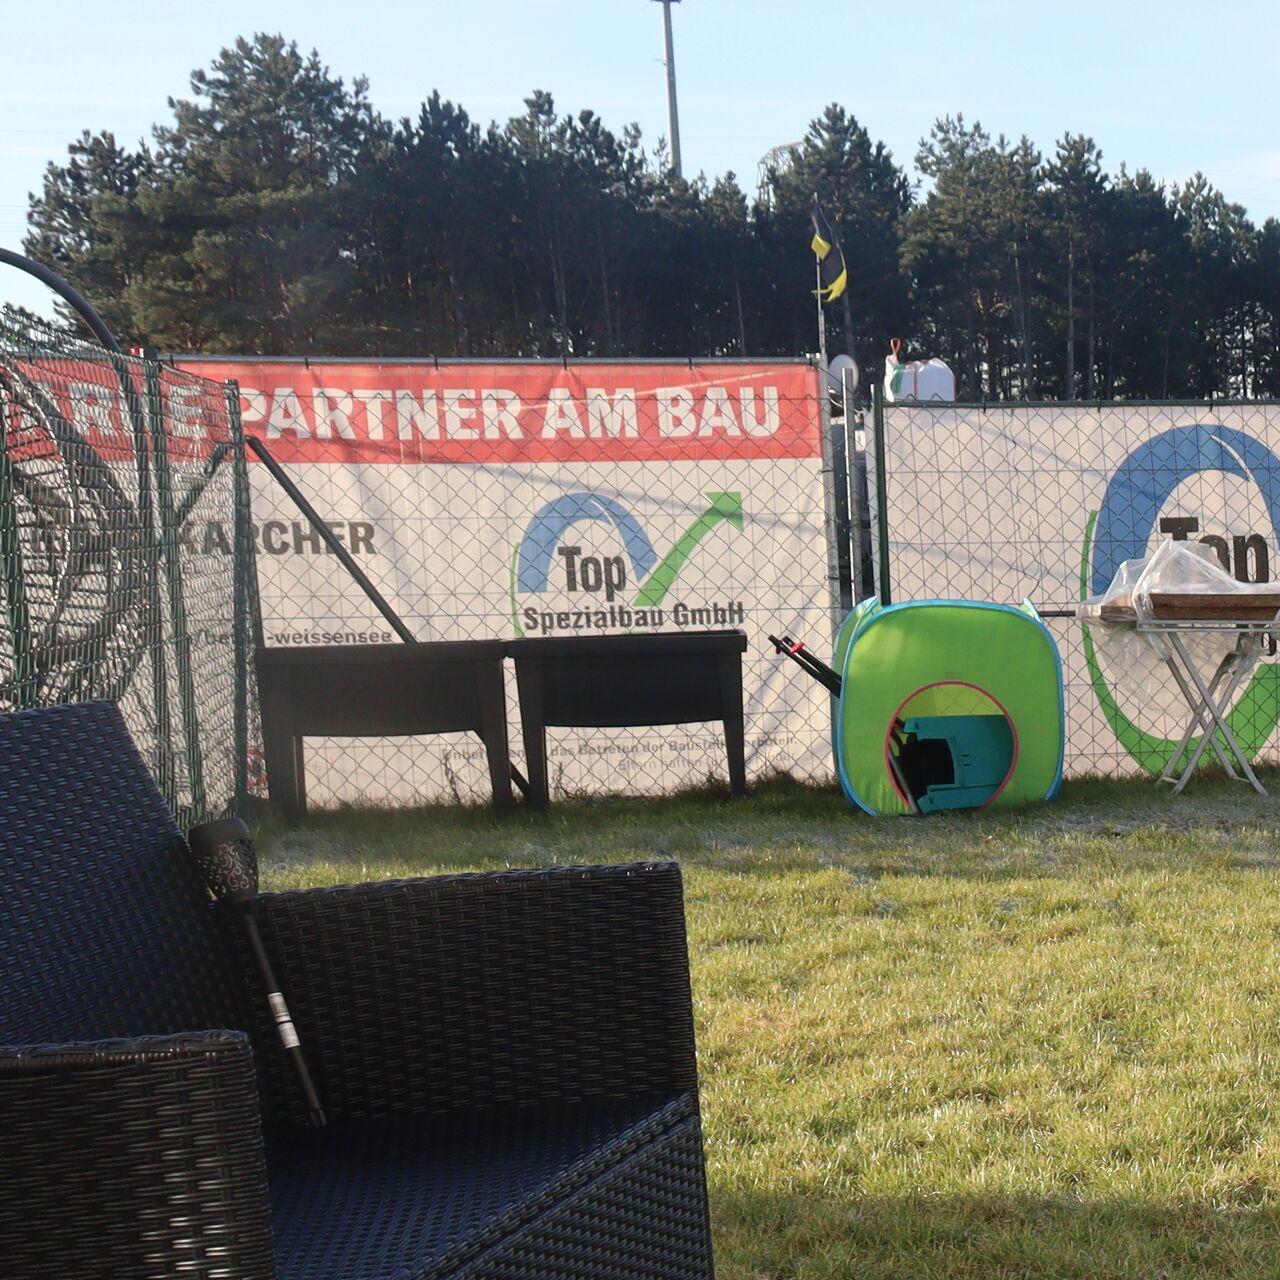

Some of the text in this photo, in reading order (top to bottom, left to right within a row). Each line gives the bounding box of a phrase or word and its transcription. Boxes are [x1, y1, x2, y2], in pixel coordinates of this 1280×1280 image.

[237, 387, 524, 440] PARTNER
[540, 387, 637, 439] AM
[656, 385, 780, 438] BAU
[558, 546, 626, 602] Top
[524, 601, 744, 635] Spezialbau GmbH
